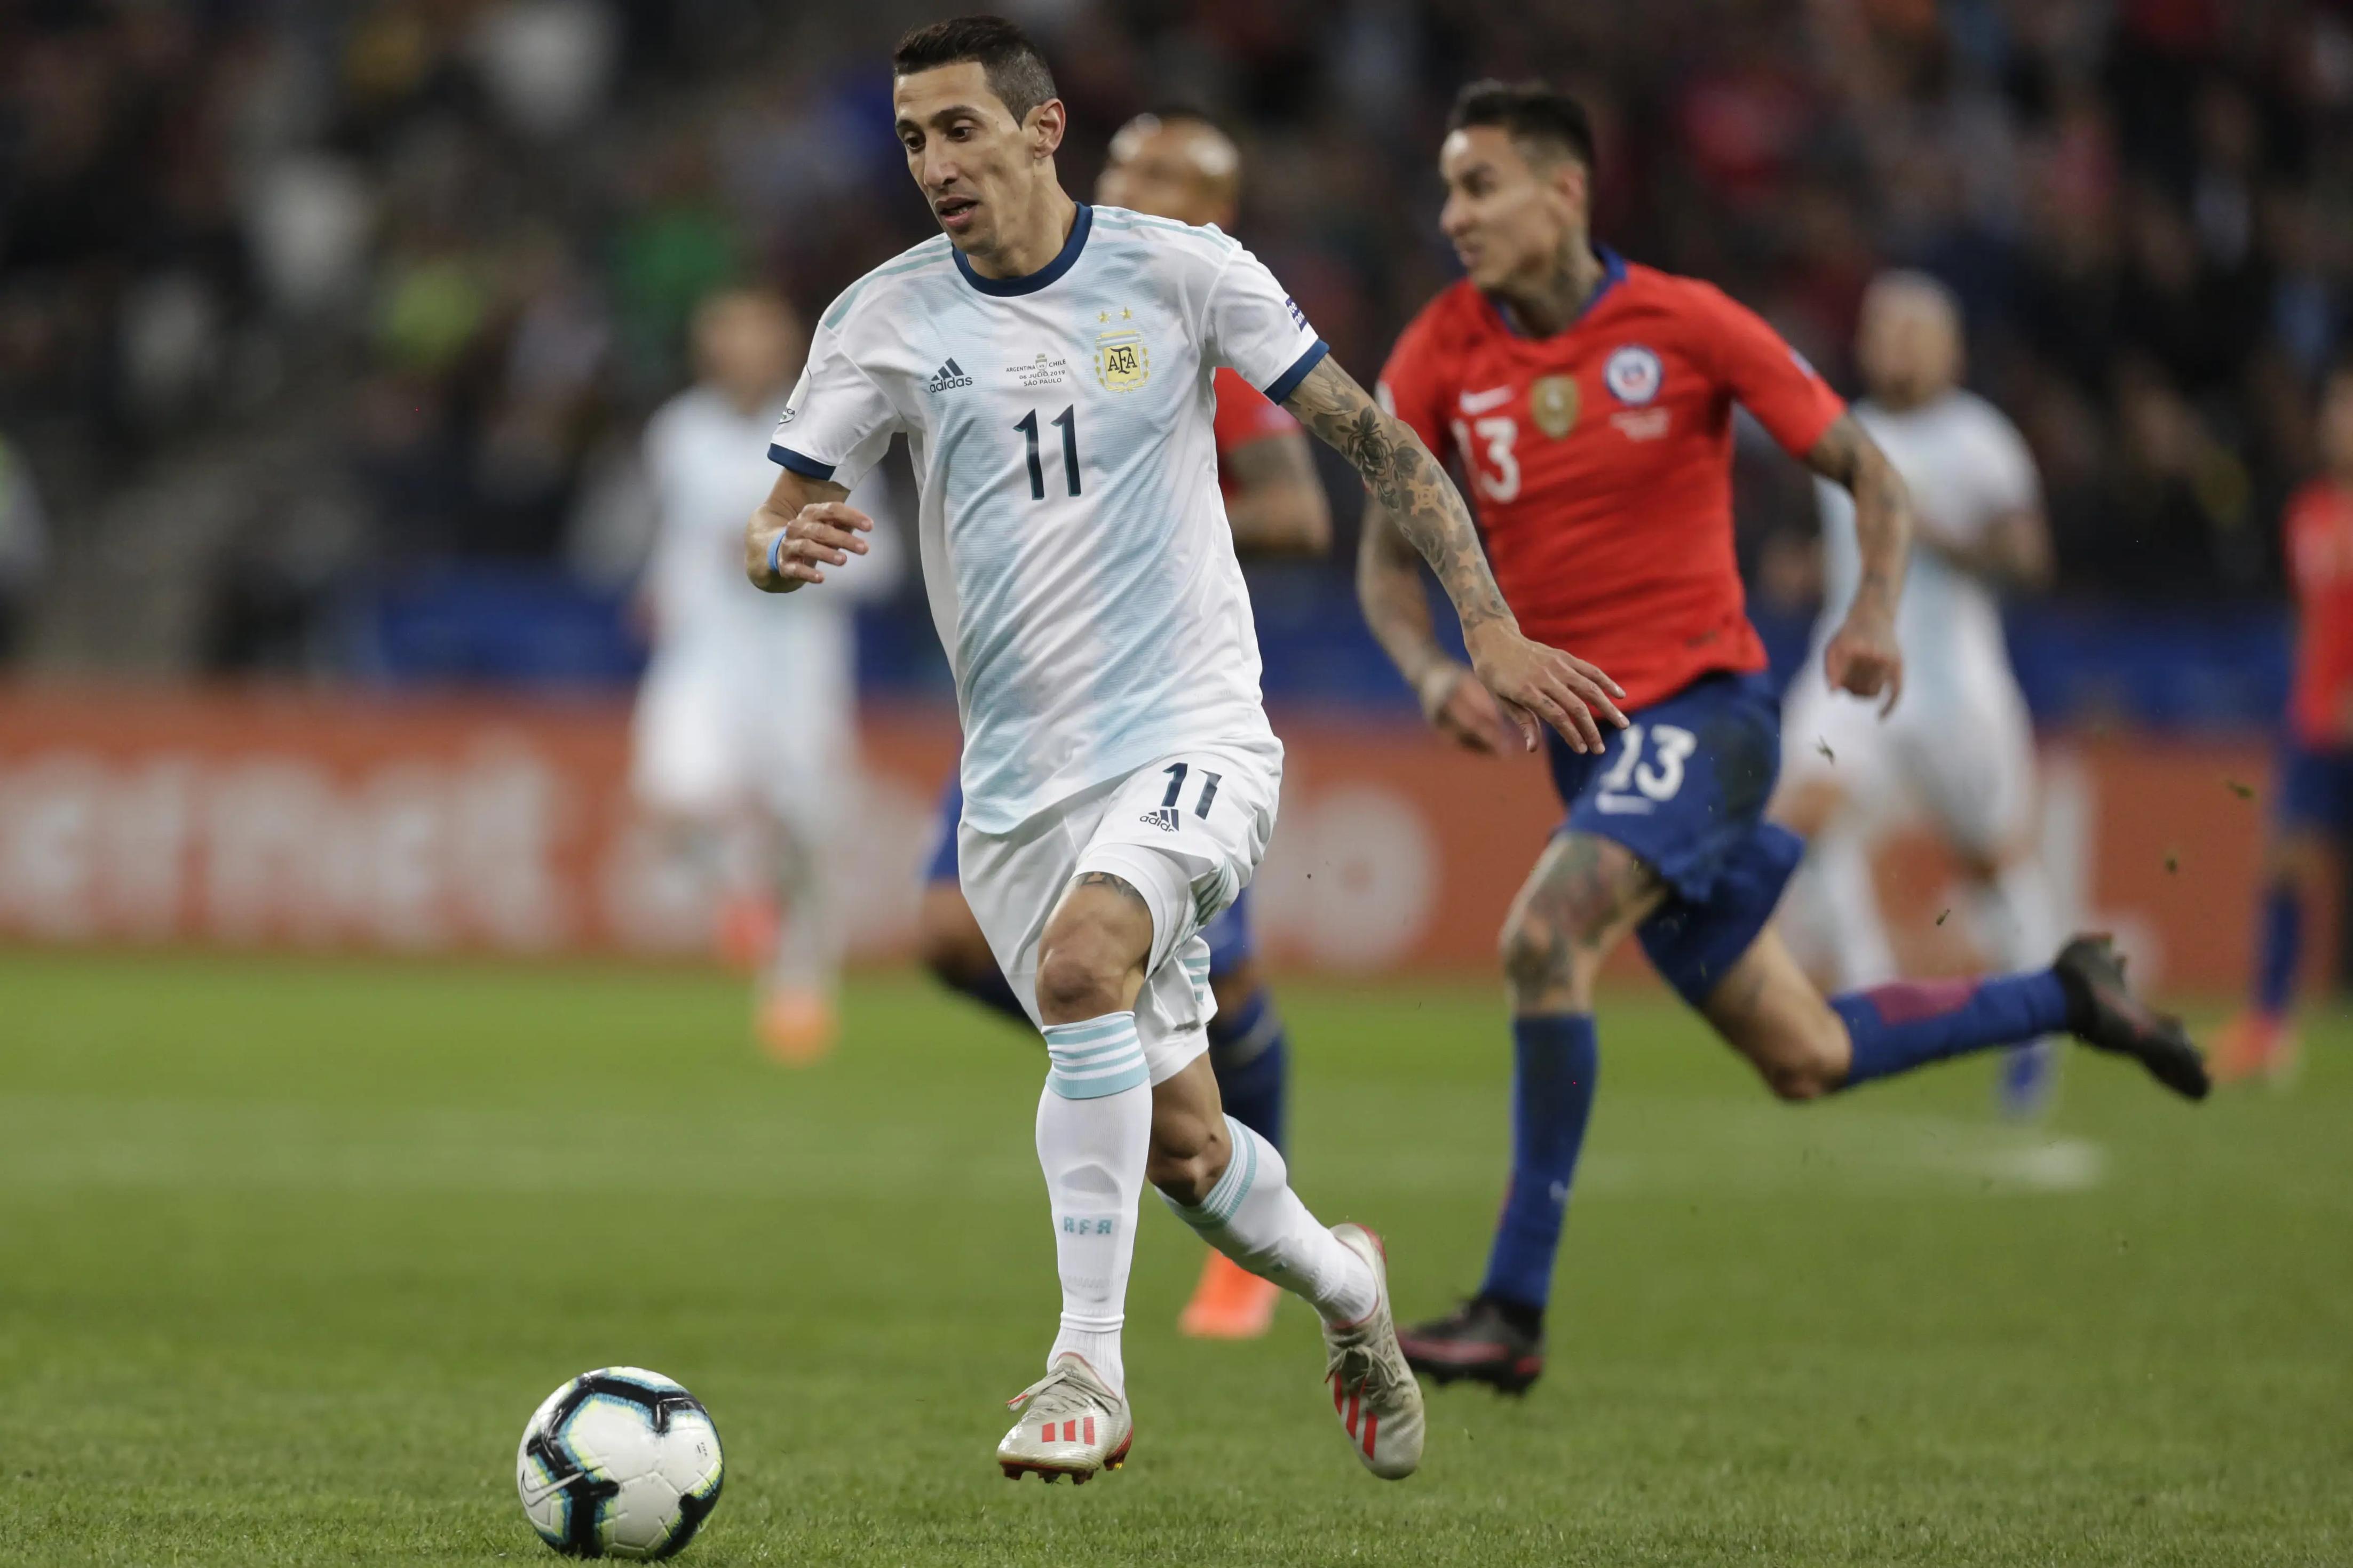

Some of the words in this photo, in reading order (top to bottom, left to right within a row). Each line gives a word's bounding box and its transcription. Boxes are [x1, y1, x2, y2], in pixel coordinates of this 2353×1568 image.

[930, 377, 973, 393] adidas
[1005, 364, 1036, 372] ARGENTINA
[1048, 359, 1066, 368] CHILE
[1107, 346, 1138, 374] AFA
[1013, 404, 1081, 500] 11
[1451, 417, 1521, 504] 13
[1161, 762, 1223, 821] 11
[1599, 723, 1698, 802] 13
